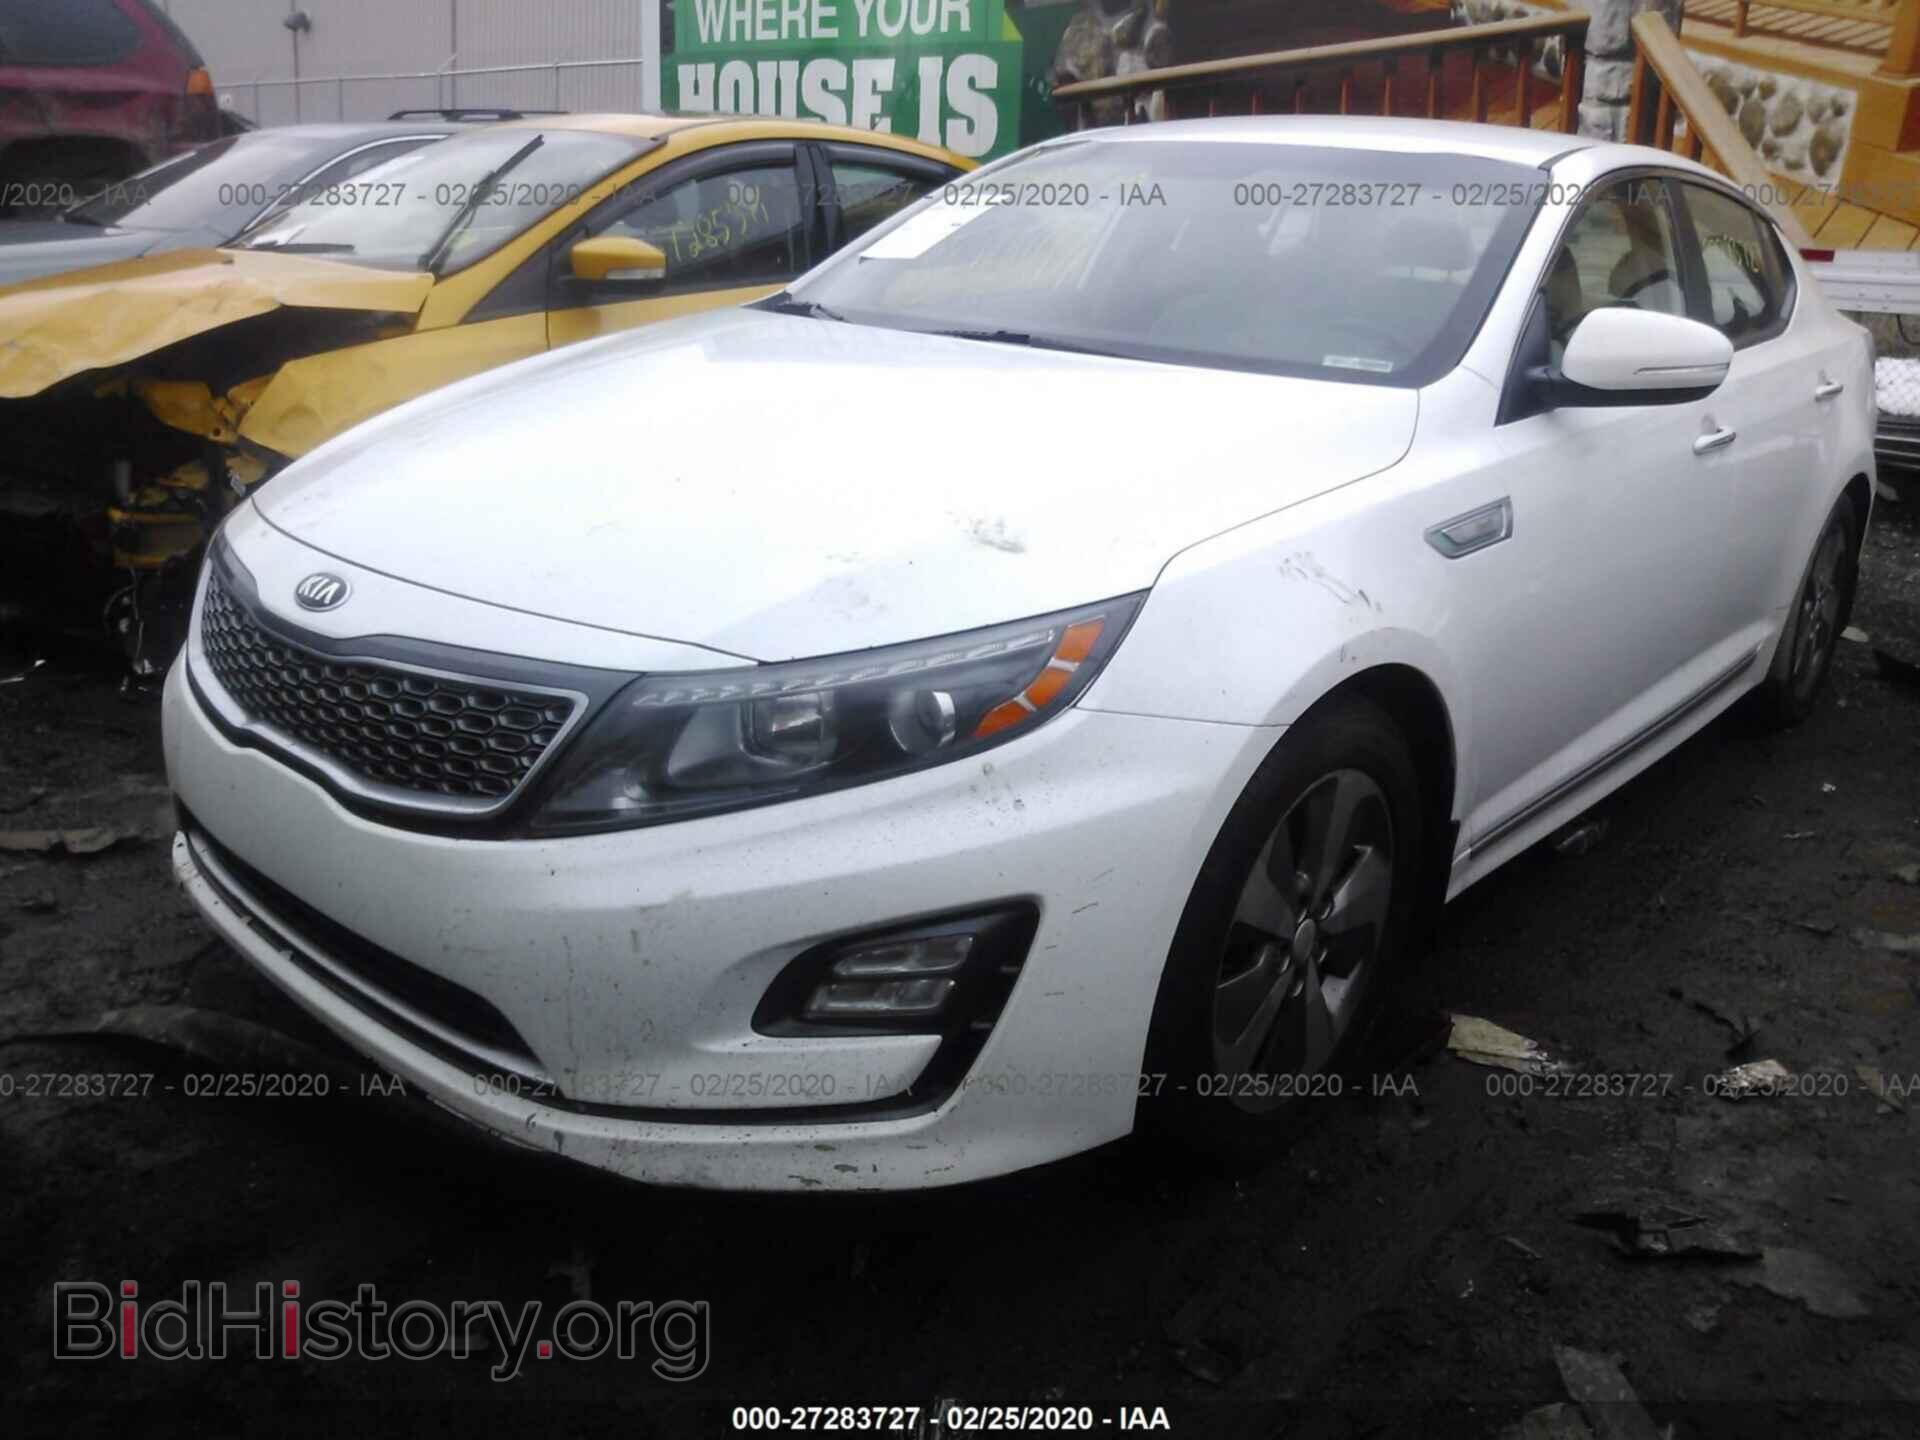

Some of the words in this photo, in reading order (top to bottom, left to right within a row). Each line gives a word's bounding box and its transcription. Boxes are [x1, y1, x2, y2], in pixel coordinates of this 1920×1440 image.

[694, 0, 839, 44] WHERE
[852, 0, 972, 38] YOUR
[916, 53, 999, 158] IS
[298, 575, 341, 605] KIA
